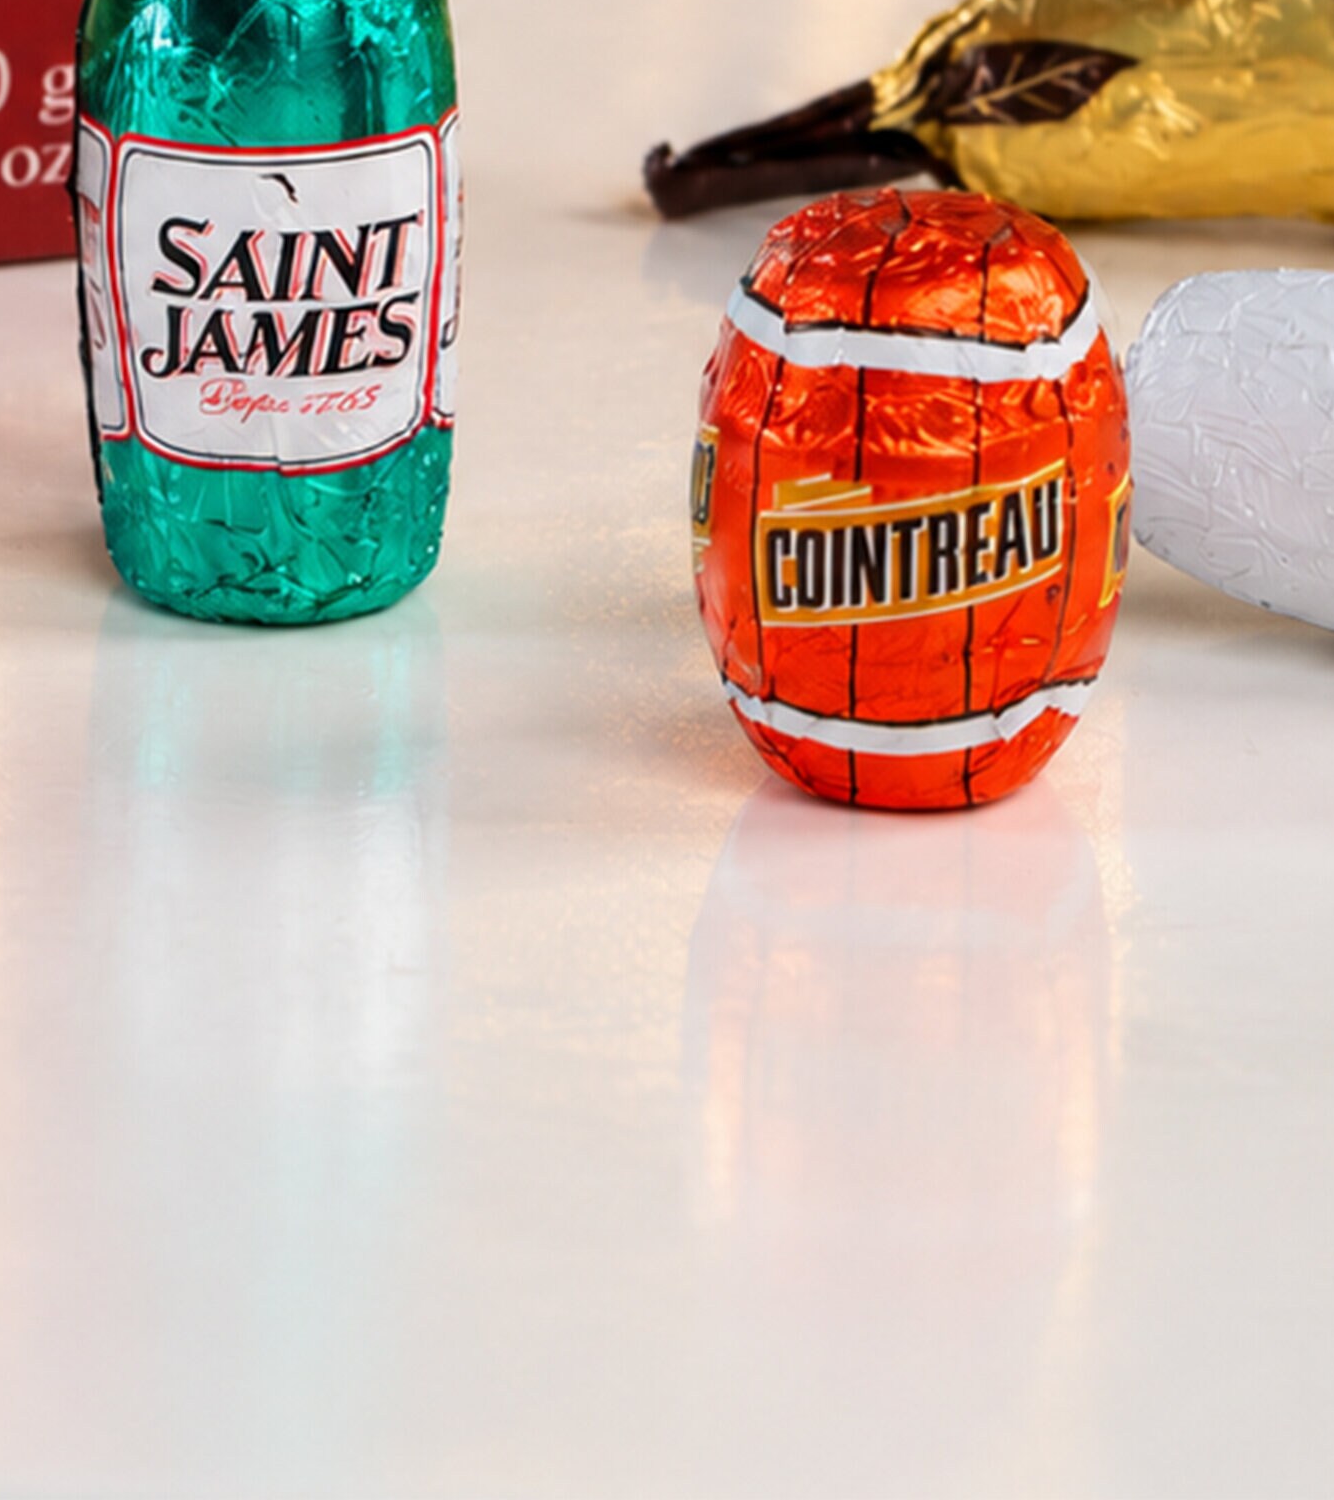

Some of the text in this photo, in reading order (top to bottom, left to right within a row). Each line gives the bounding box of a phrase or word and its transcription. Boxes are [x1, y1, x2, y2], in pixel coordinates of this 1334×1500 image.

[150, 210, 425, 301] SAINT
[141, 291, 421, 379] JAMES
[765, 472, 1064, 609] COINTREAU
